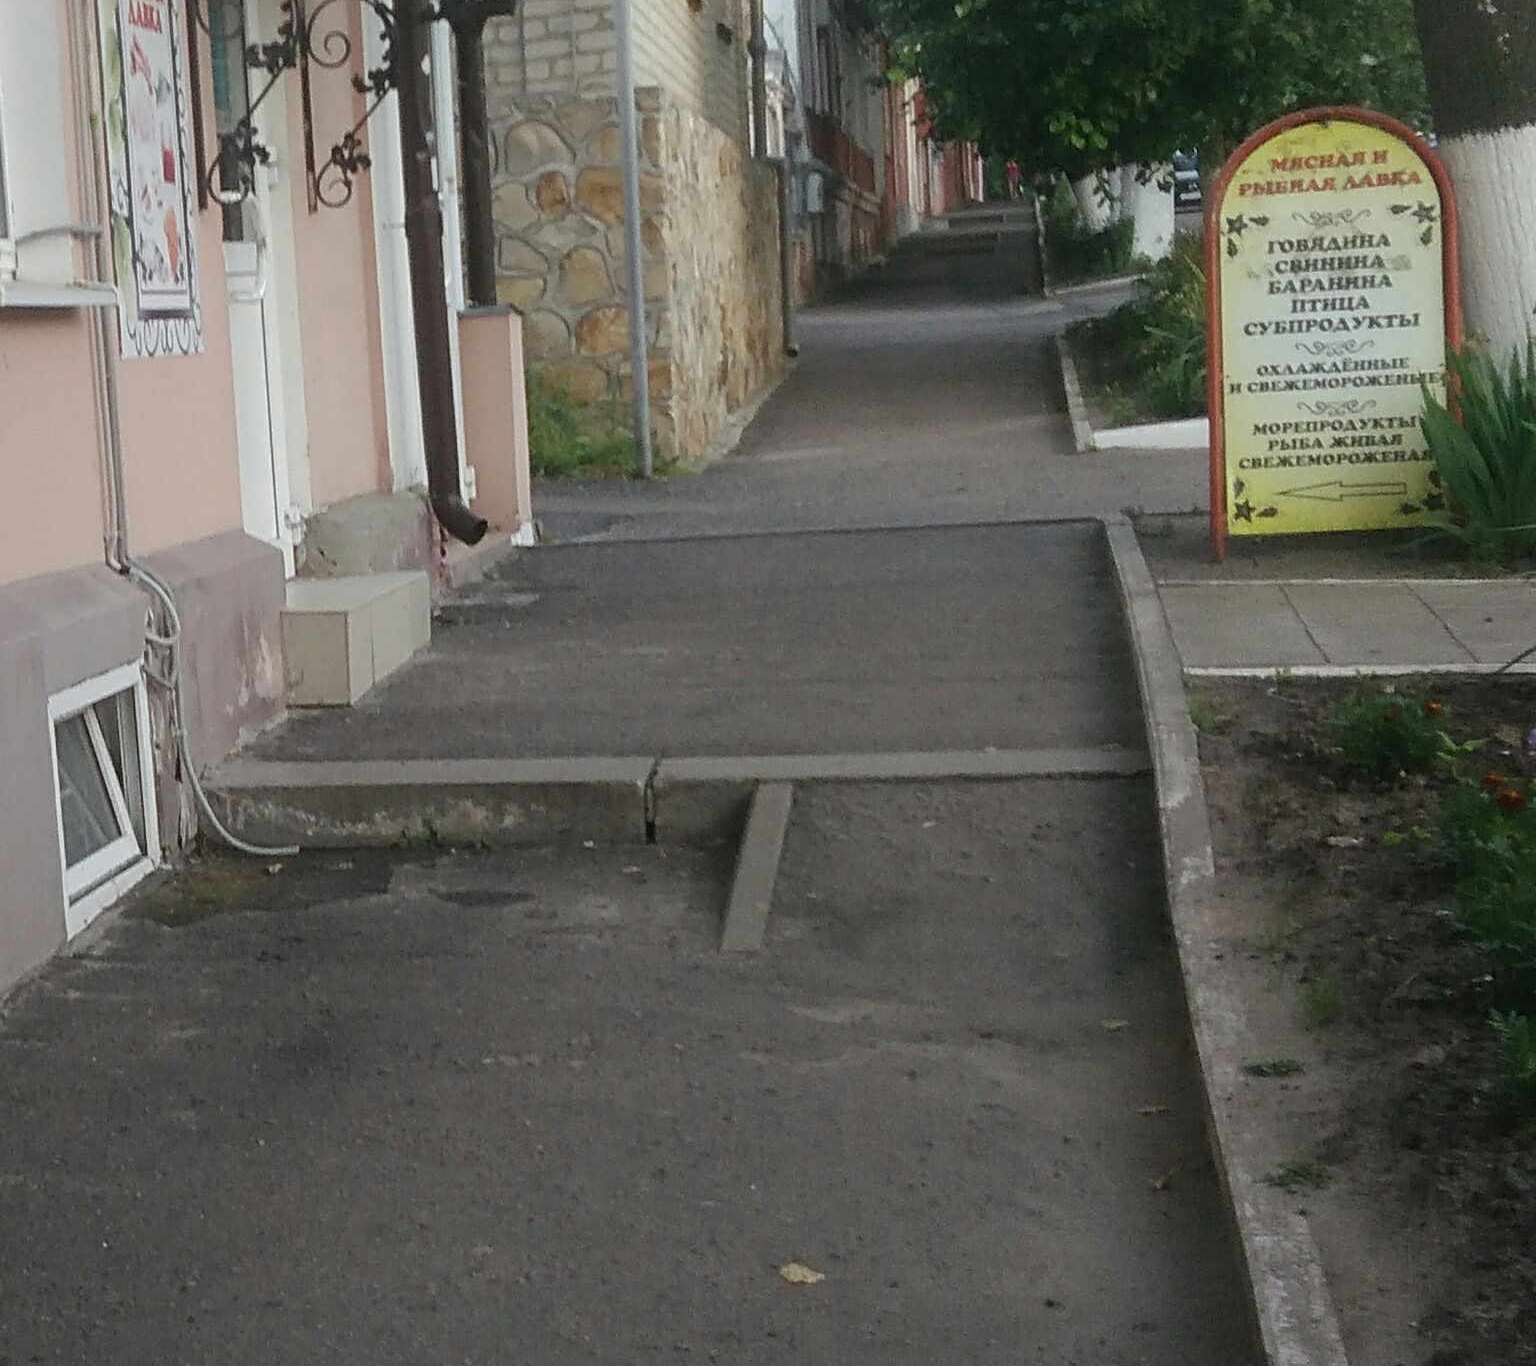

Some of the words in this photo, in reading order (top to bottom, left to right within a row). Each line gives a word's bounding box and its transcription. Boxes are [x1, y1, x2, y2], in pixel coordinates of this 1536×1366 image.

[1270, 150, 1365, 173] МЯСНАЯ
[1373, 149, 1389, 165] И
[1238, 176, 1337, 196] РЫБНАЯ
[1343, 170, 1422, 190] ЛАВКА
[1267, 233, 1392, 255] ГОВЯДИНА
[1275, 254, 1386, 275] СВИНИНА
[1268, 274, 1393, 295] БАРАНИНА
[1290, 295, 1370, 314] ПТИЦА
[1243, 312, 1421, 336] СУБПРОДУКТЫ
[1256, 357, 1410, 377] ОХЛАЖДЁННЫЕ
[1229, 382, 1242, 394] И
[1253, 415, 1418, 436] МОРЕПРОДУКТЫ
[1267, 436, 1324, 452] РЫБА
[1329, 434, 1404, 449] ЖИВАЯ
